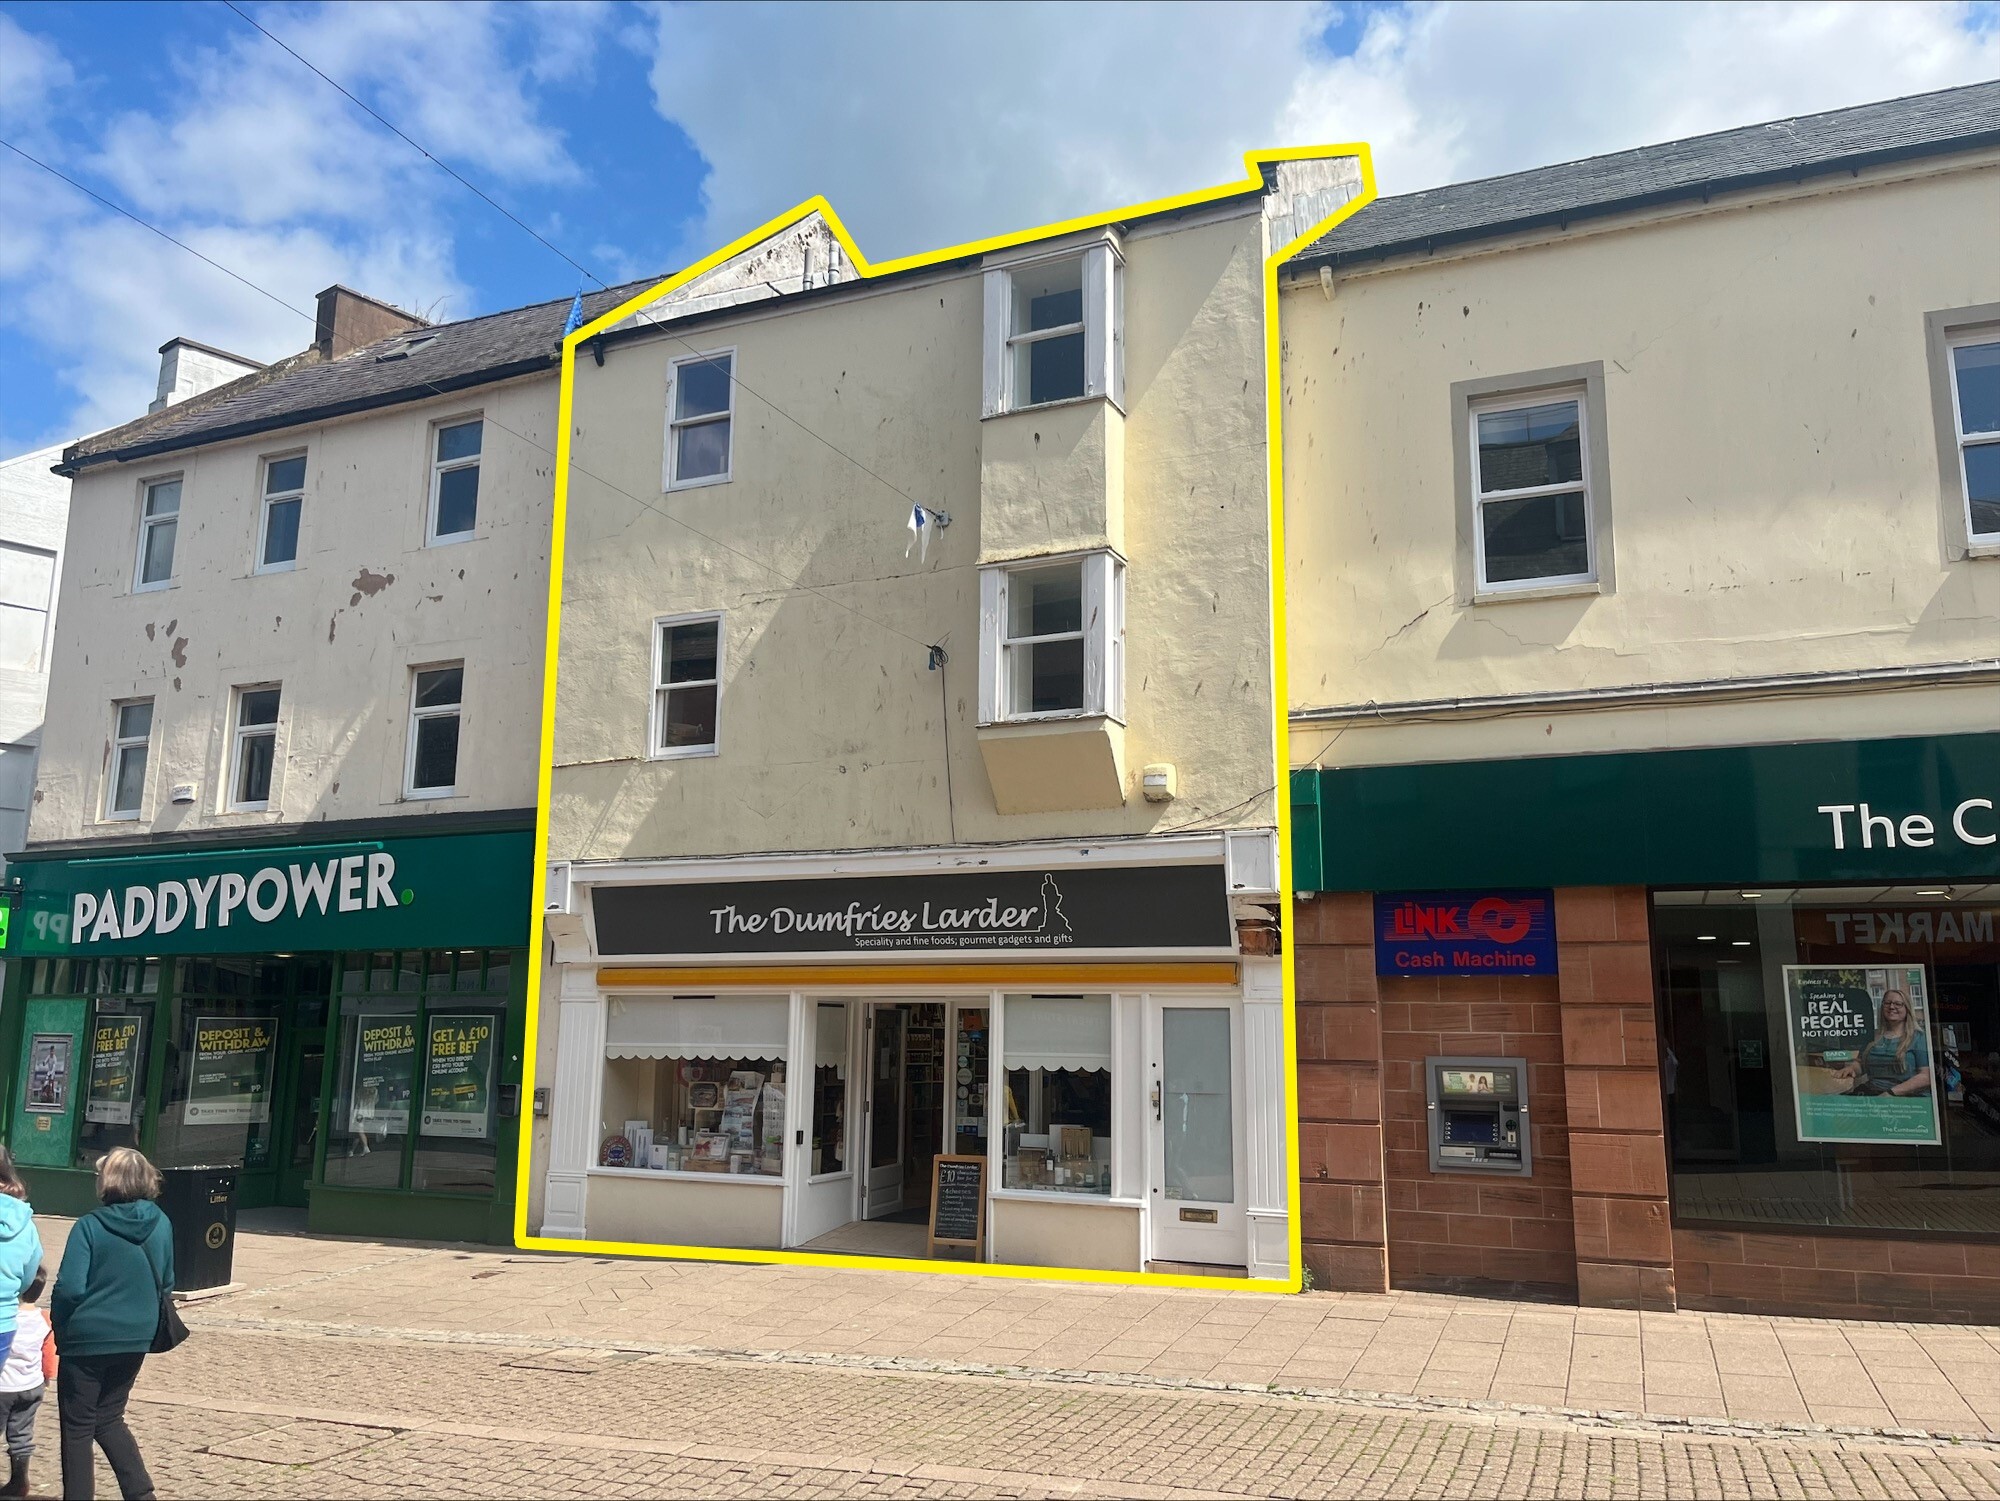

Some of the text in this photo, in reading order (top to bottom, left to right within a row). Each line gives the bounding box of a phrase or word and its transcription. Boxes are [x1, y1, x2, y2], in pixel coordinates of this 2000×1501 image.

[1817, 803, 1934, 849] The
[709, 897, 1038, 937] The Dumfries Larder
[855, 933, 1073, 948] Speciality and fine foods; gourmet gadgets and gifts
[1395, 951, 1536, 968] Cash Machine
[1809, 993, 1836, 1001] Speaking
[1808, 1000, 1853, 1014] REAL
[1801, 1014, 1865, 1029] PEOPLE
[98, 1025, 136, 1040] GET A £10
[200, 1027, 264, 1041] DEPOSIT &
[364, 1025, 412, 1041] DEPOSIT &
[433, 1026, 488, 1042] GET A £10
[1824, 1029, 1859, 1037] ROBOTS
[96, 1037, 129, 1052] FREE BET
[200, 1036, 271, 1051] WITHDRAW
[432, 1040, 479, 1056] FREE BET
[940, 1170, 956, 1183] £10
[210, 1196, 228, 1204] Litter
